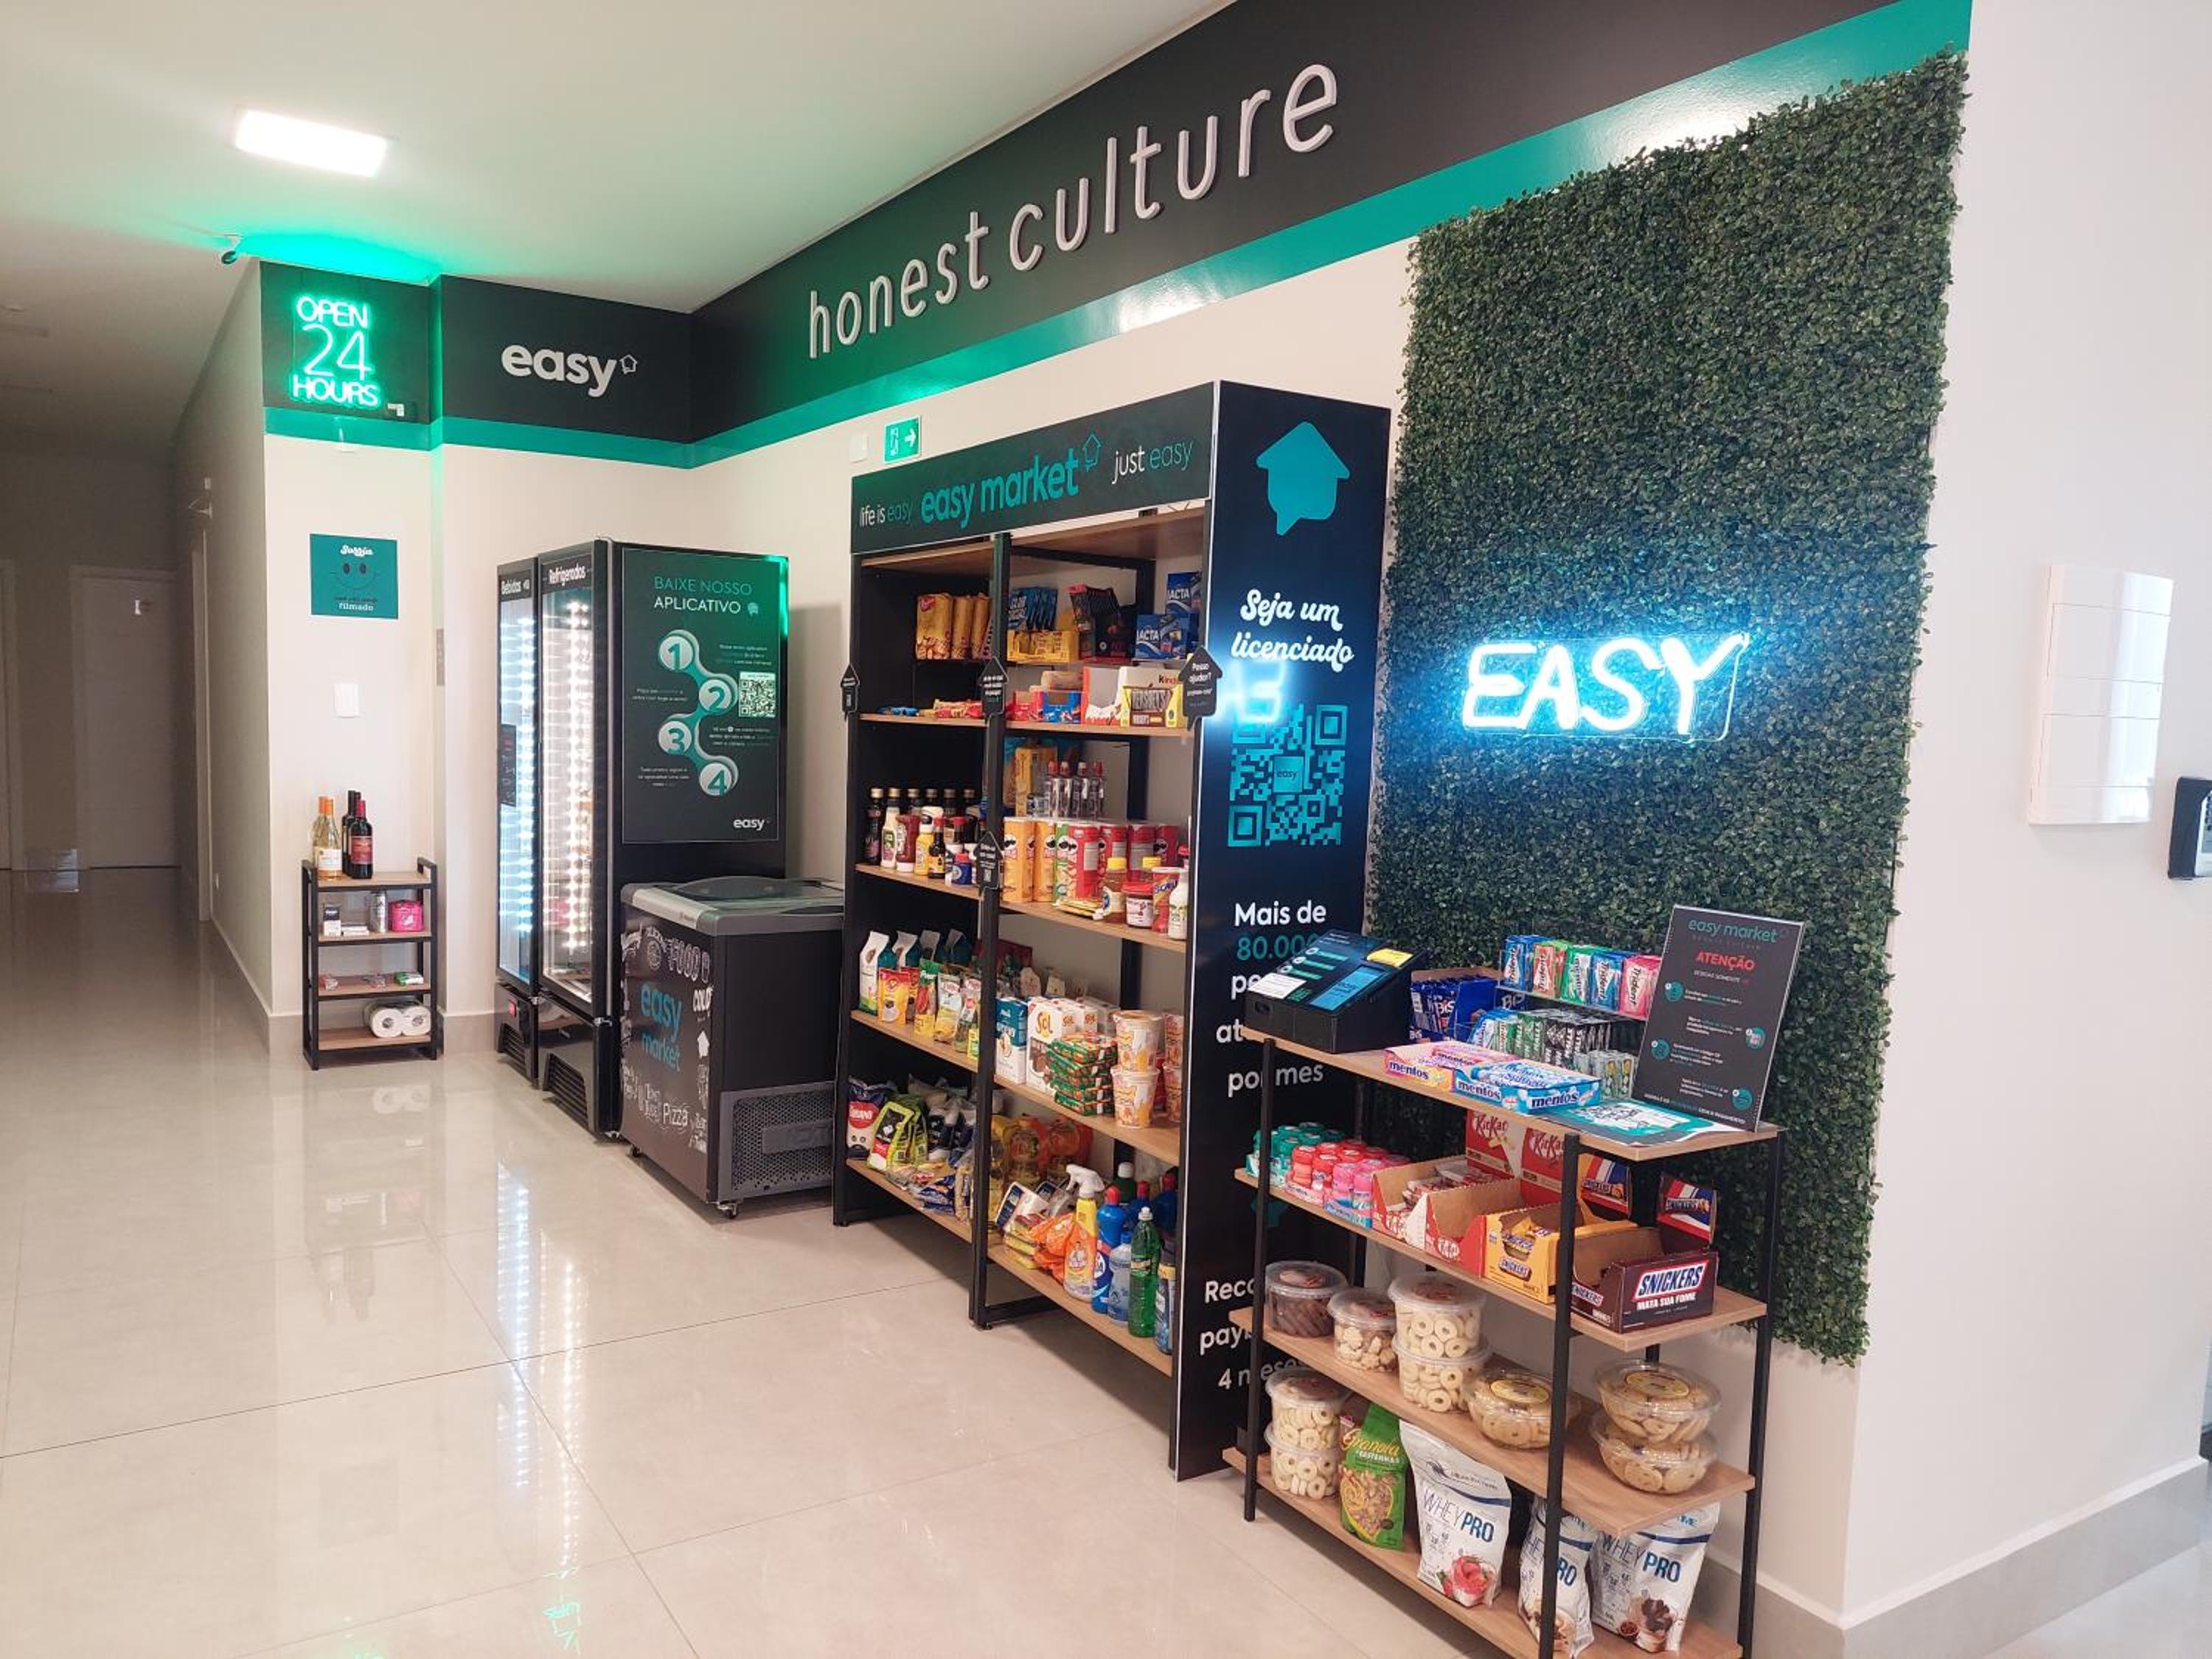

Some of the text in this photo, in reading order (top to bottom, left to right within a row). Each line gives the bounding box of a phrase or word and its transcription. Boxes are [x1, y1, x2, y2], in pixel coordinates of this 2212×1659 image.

[810, 62, 1338, 361] honest culture
[296, 296, 368, 329] OPEN
[302, 324, 372, 381] 24
[501, 344, 617, 397] easy
[293, 375, 378, 407] HOURS
[1111, 440, 1194, 484] just easy
[922, 448, 1079, 529] easy market
[859, 504, 875, 527] life
[877, 504, 886, 524] is
[653, 576, 753, 597] BAIXE NOSSO
[653, 597, 742, 614] APLICATIVO
[1240, 589, 1344, 633] Seja um
[667, 643, 681, 670] 1
[1231, 632, 1355, 673] licenciado
[1462, 631, 1749, 737] EASY
[708, 686, 728, 713] 2
[667, 727, 685, 754] 3
[707, 770, 728, 797] 4
[1276, 768, 1298, 780] easy
[733, 816, 765, 830] easy
[1234, 900, 1327, 927] Mais de
[1688, 919, 1722, 937] easy
[1724, 925, 1778, 943] market
[1697, 951, 1756, 972] ATENÇÃO
[1599, 962, 1610, 1001] Trident
[1630, 967, 1642, 1006] Trident
[641, 982, 683, 1043] easy
[641, 1033, 681, 1072] market
[1228, 1071, 1264, 1098] po
[1389, 1059, 1429, 1081] mentos
[1458, 1081, 1501, 1102] mentos
[1531, 1090, 1581, 1109] mentos
[1475, 1113, 1509, 1141] KitKat
[1532, 1133, 1563, 1163] KitKa
[1638, 1265, 1704, 1297] SNICKERS
[1636, 1298, 1658, 1311] MATA
[1660, 1295, 1674, 1308] SUA
[1675, 1292, 1697, 1304] FOME
[1218, 1368, 1232, 1390] 4
[1341, 1429, 1400, 1458] Granola
[1424, 1488, 1495, 1543] WHEY PRO
[1557, 1557, 1577, 1587] RO
[1602, 1534, 1682, 1582] WHEY PRO
